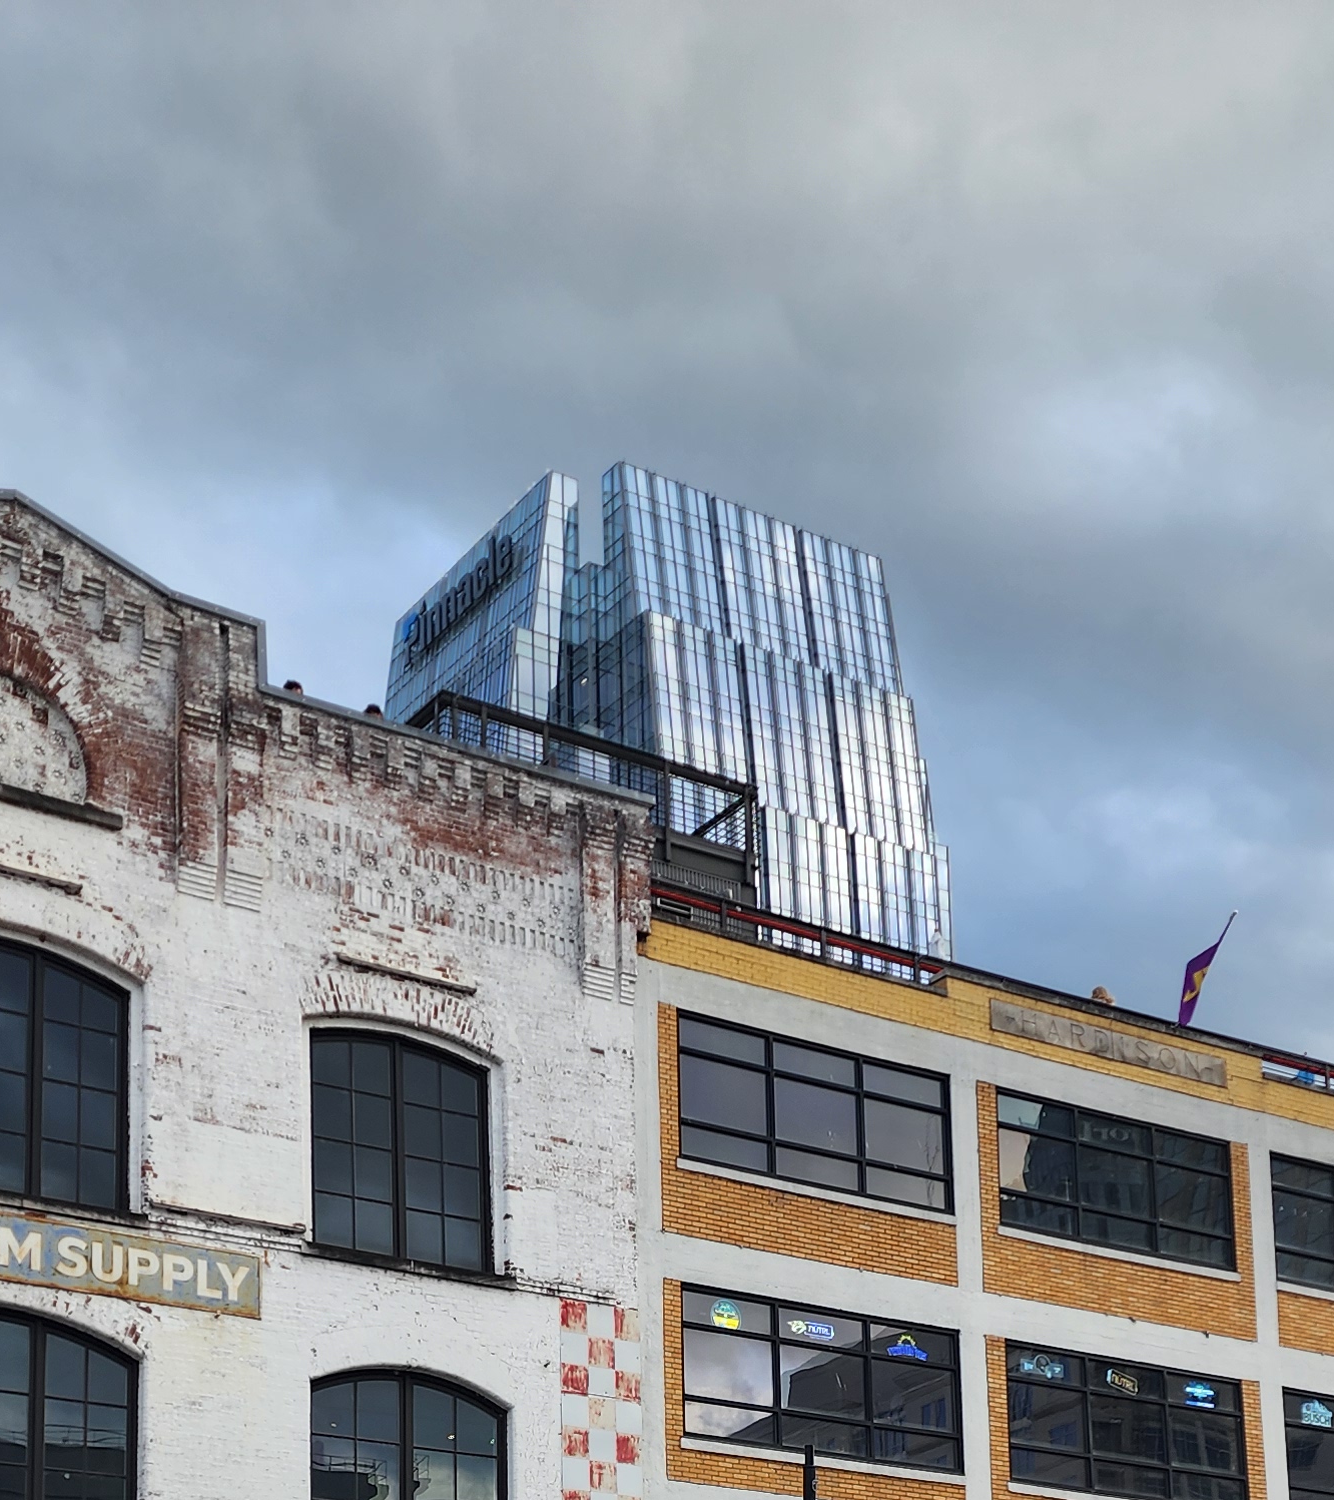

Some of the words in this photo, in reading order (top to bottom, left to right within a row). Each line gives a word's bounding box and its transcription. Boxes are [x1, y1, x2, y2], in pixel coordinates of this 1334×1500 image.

[403, 534, 513, 668] Pinnacle
[55, 1240, 250, 1301] SUPPLY
[1303, 1412, 1331, 1425] BUSCH
